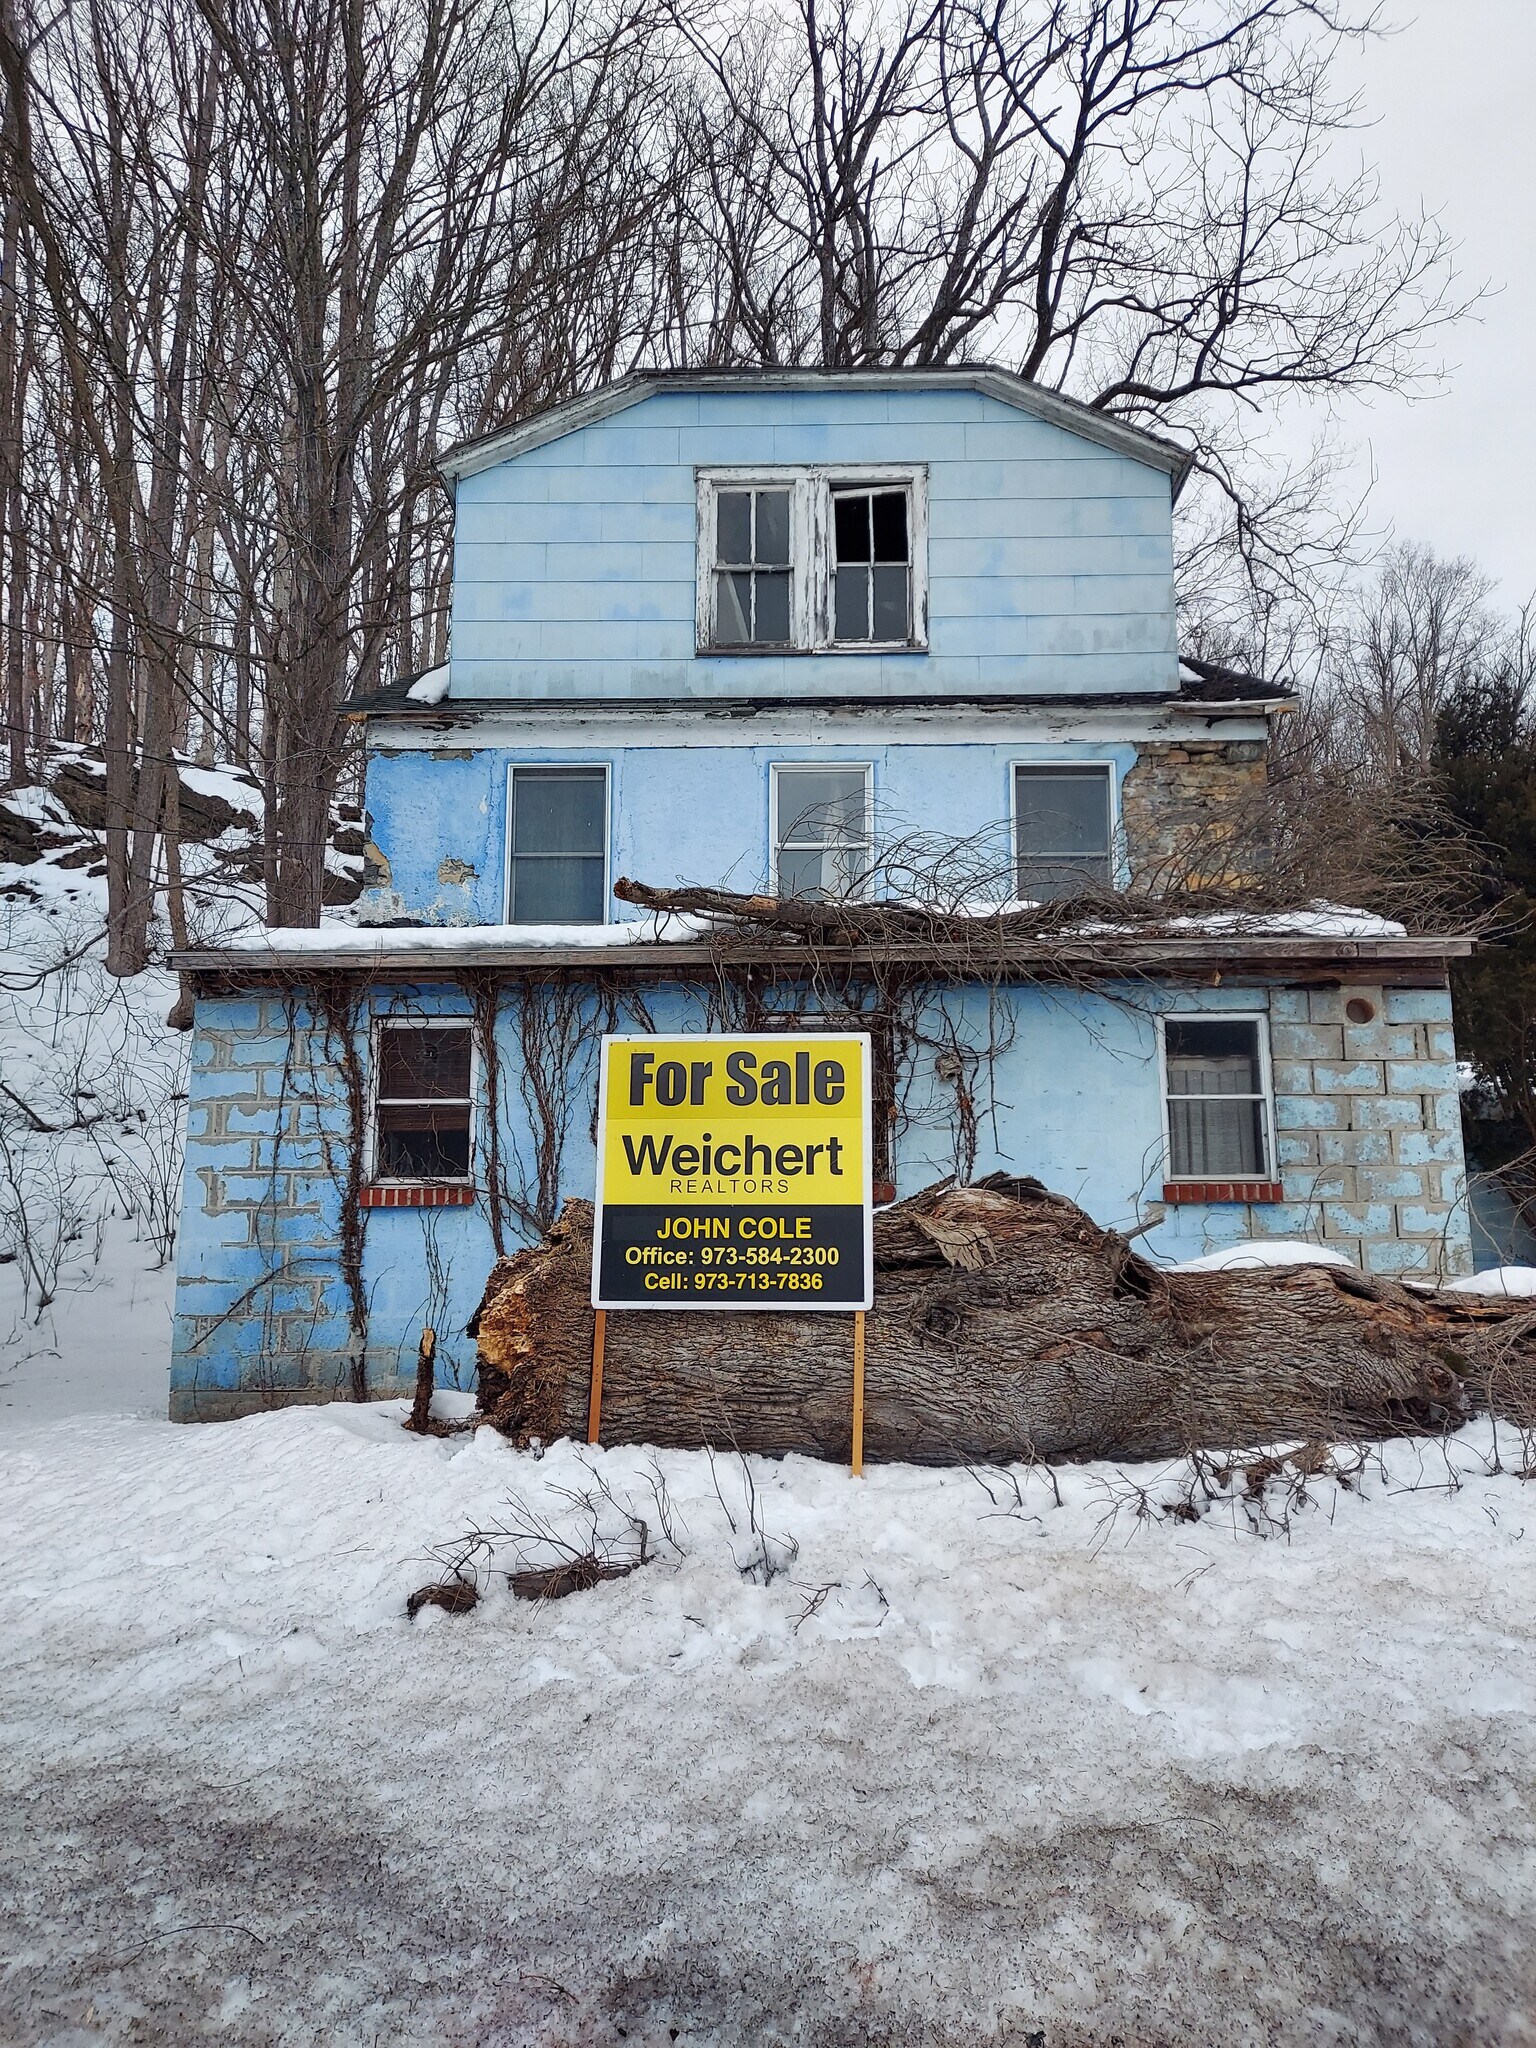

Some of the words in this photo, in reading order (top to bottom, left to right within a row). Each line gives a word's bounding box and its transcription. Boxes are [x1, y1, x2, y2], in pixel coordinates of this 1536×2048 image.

[629, 1053, 713, 1106] For
[726, 1051, 845, 1106] Sale
[622, 1133, 843, 1176] Weichert
[670, 1179, 789, 1194] REALTORS
[656, 1217, 730, 1239] JOHN
[738, 1217, 812, 1239] COLE
[625, 1246, 694, 1265] Office:
[701, 1247, 839, 1265] 973-584-2300
[644, 1273, 688, 1290] Cell:
[694, 1273, 823, 1290] 973-713-7836
